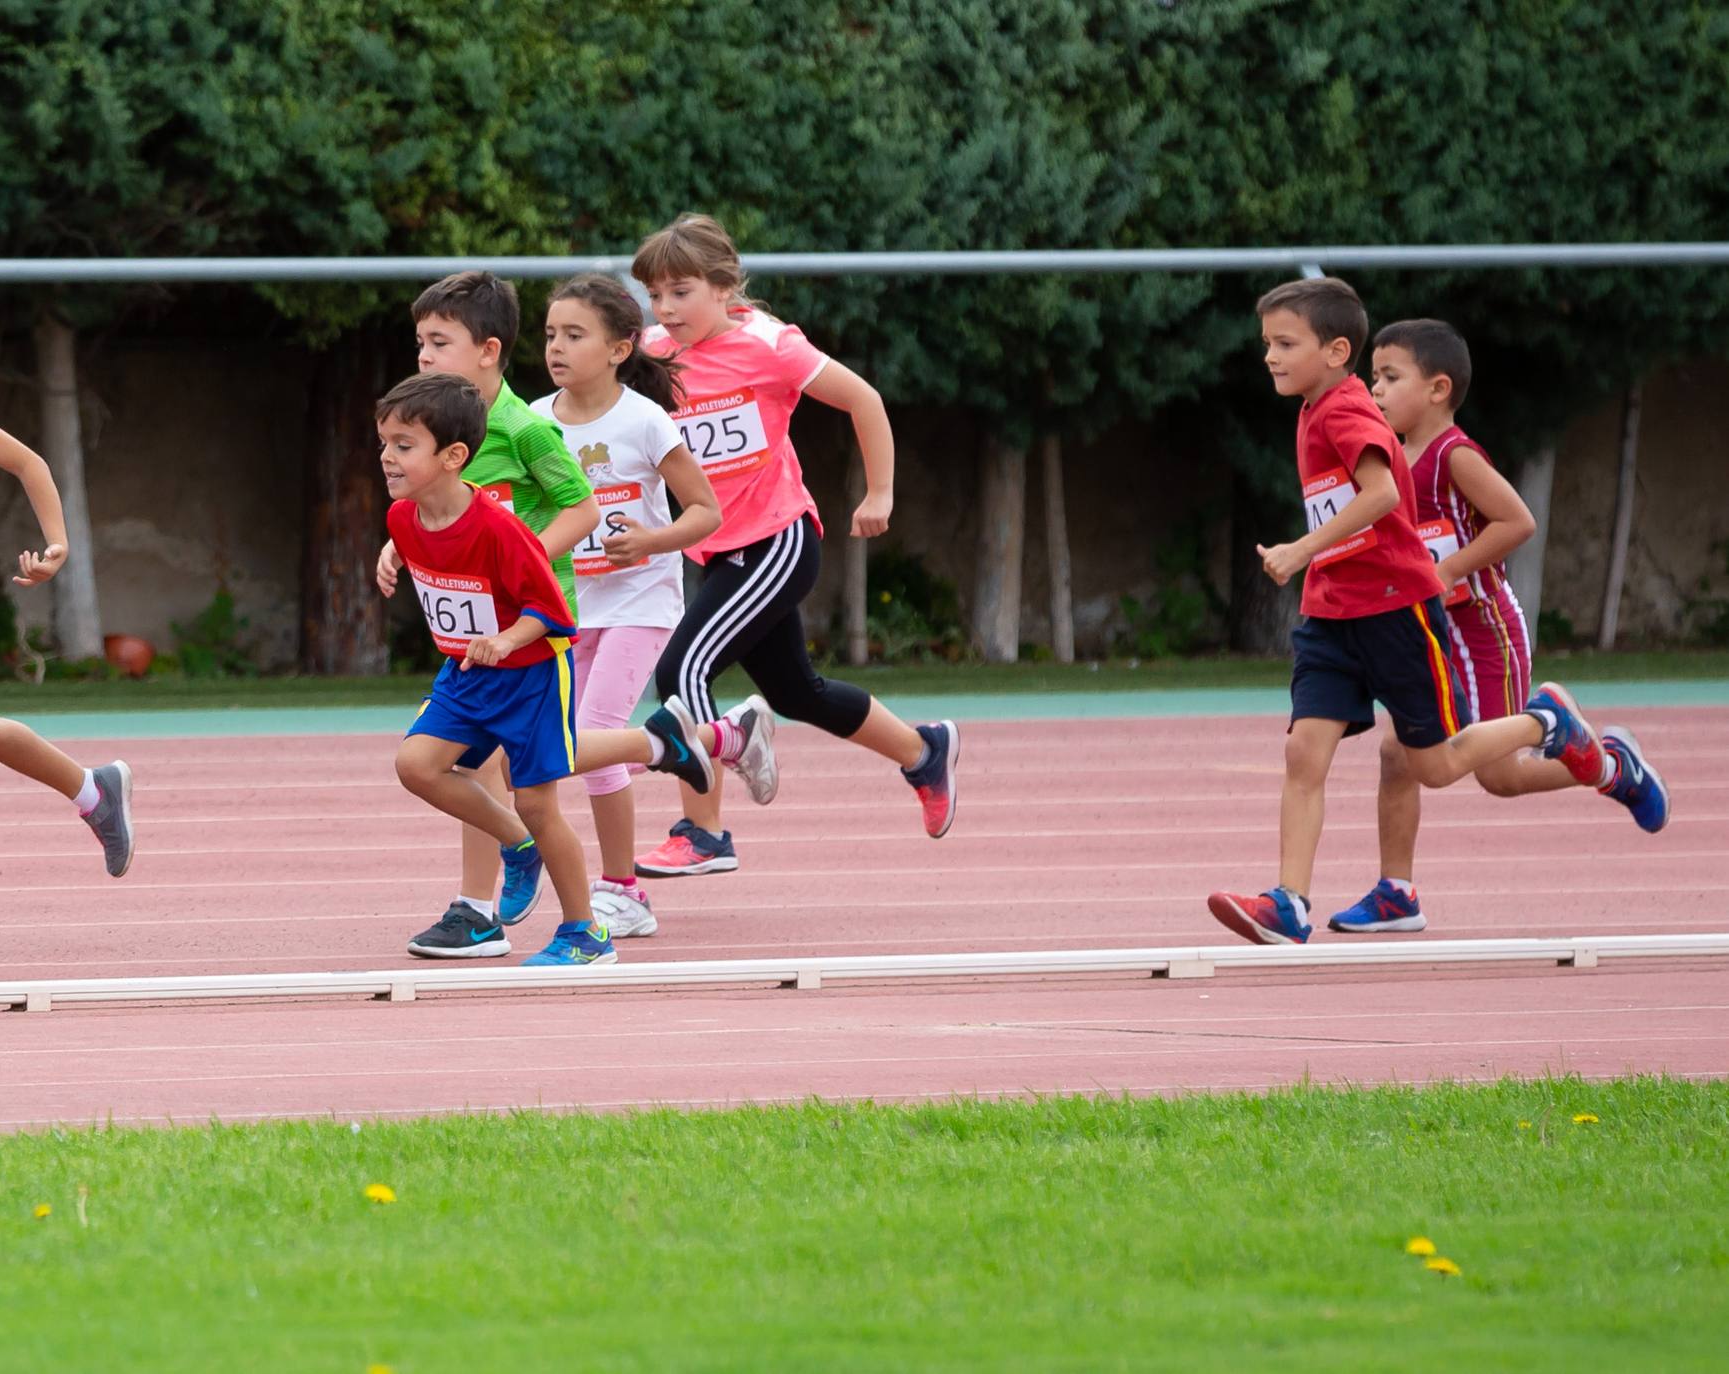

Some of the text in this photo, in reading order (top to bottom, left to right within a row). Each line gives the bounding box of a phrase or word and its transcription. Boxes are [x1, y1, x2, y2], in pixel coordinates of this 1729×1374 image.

[695, 394, 744, 413] ATLETISMO
[434, 577, 484, 592] ATLETISMO
[422, 591, 485, 635] 461
